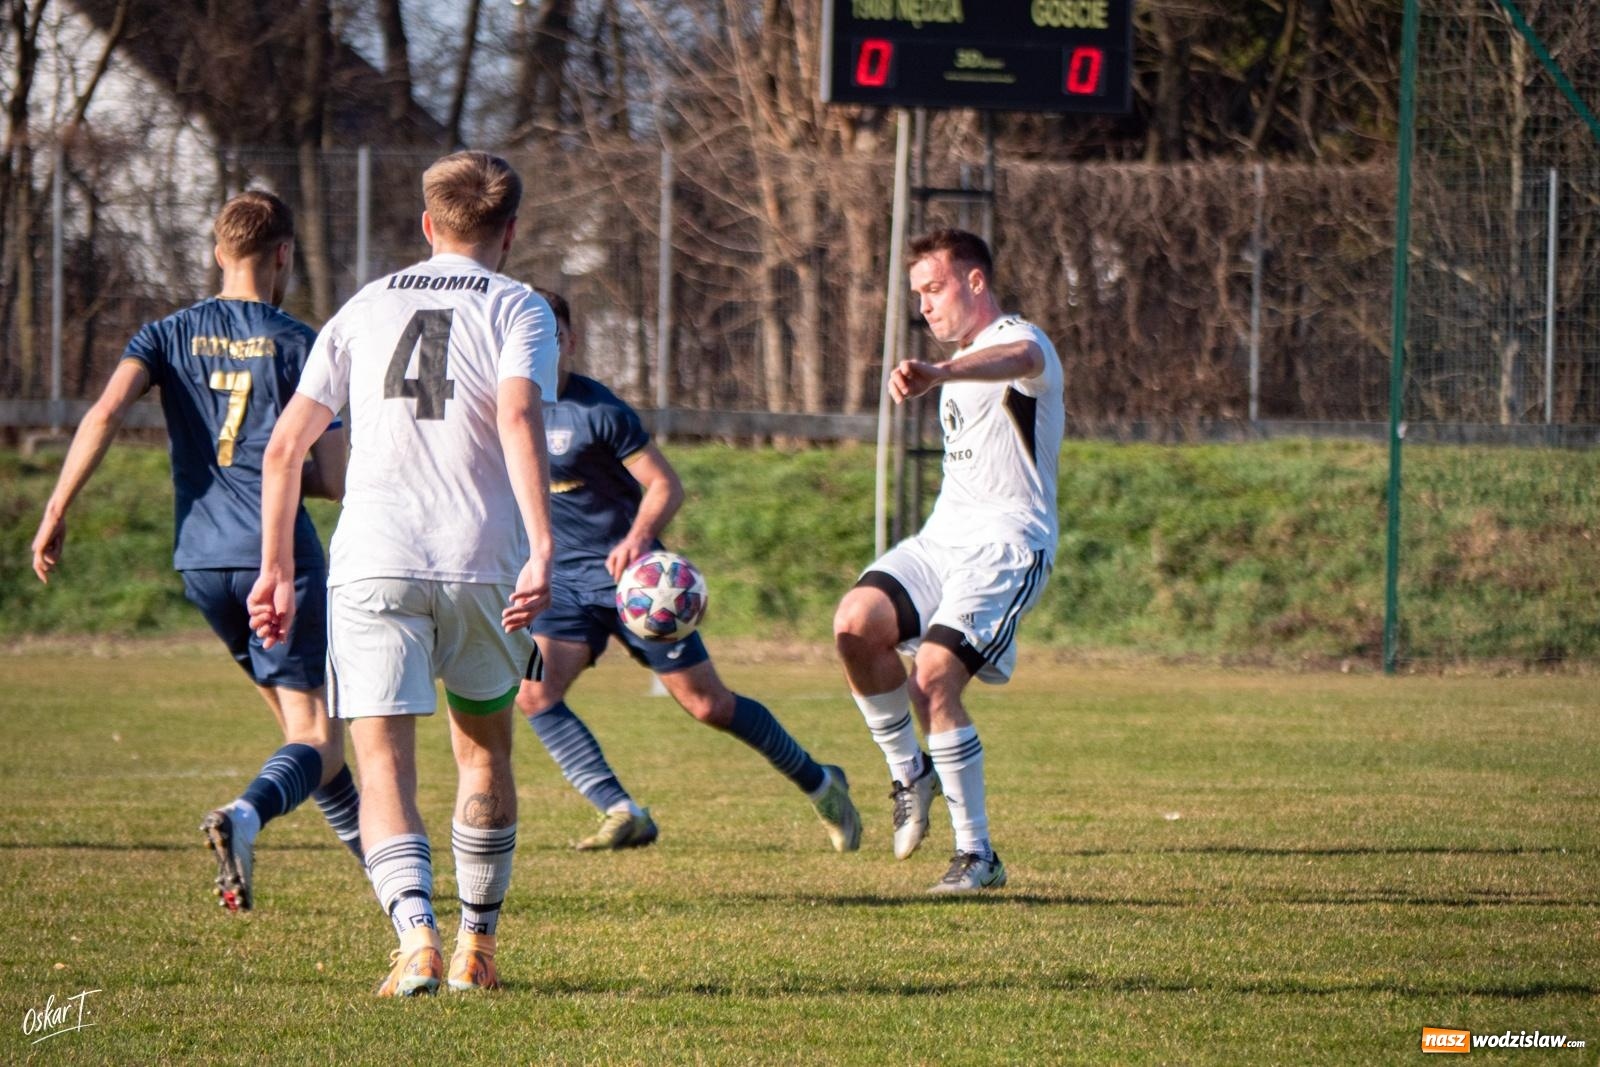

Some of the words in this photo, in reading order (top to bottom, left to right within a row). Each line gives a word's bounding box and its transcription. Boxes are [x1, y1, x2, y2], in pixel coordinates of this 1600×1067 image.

[856, 38, 894, 87] 0
[1066, 46, 1104, 94] 0
[387, 275, 490, 294] LUBOMIA
[384, 308, 455, 421] 4
[210, 371, 252, 467] 7
